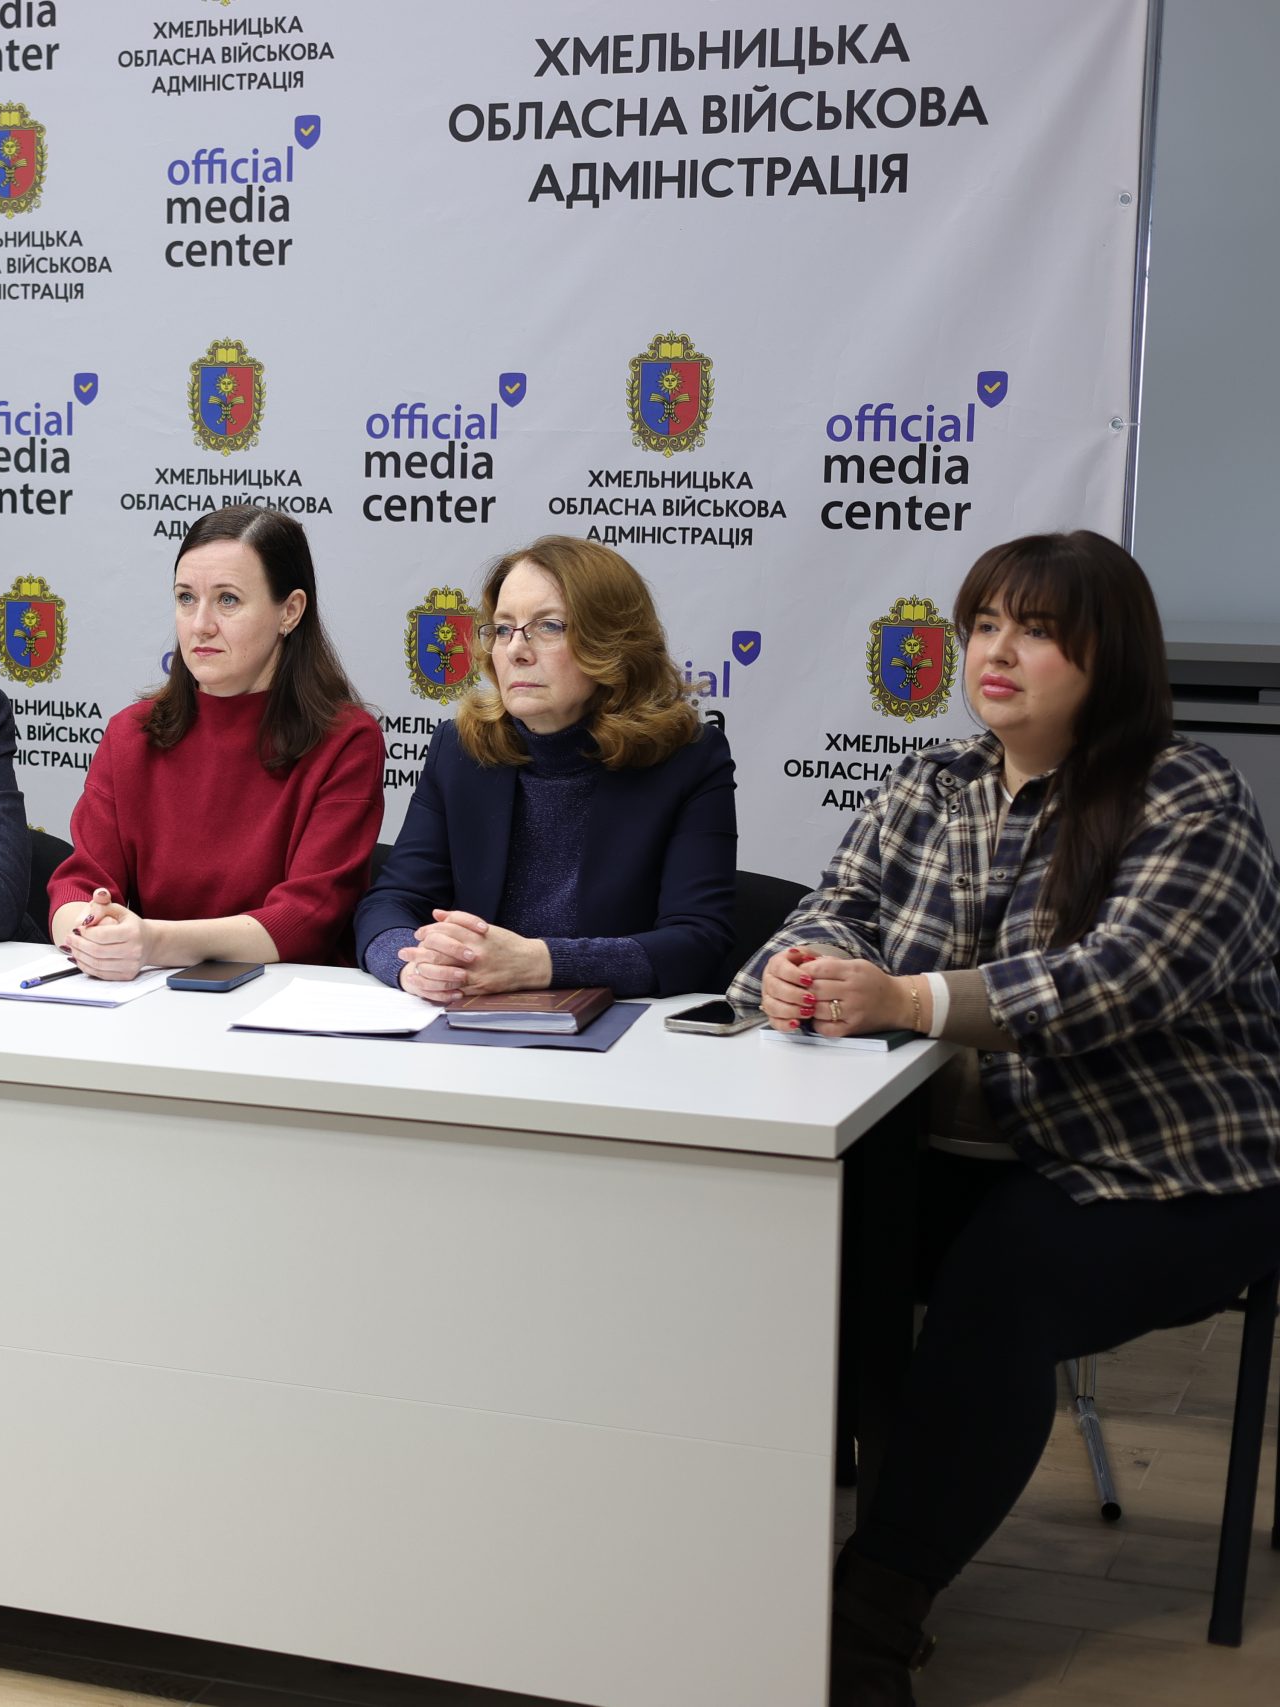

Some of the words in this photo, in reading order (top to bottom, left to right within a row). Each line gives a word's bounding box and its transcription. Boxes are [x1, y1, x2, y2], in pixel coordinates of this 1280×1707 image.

[153, 15, 304, 40] ХМЕЛЬНИЦЬКА
[117, 47, 216, 69] ОБЛАСНА
[220, 41, 335, 64] ВІЙСЬКОВА
[534, 22, 911, 78] ХМЕЛЬНИЦЬКА
[151, 70, 304, 97] АДМІНІСТРАЦІЯ
[448, 96, 688, 143] ОБЛАСНА
[702, 84, 989, 136] ВІЙСЬКОВА
[167, 145, 294, 187] official
[527, 152, 909, 210] АДМІНІСТРАЦІЯ
[166, 184, 290, 225] media
[6, 254, 113, 275] ВІЙСЬКОВА
[165, 233, 293, 268] center
[365, 402, 498, 441] official
[825, 402, 976, 444] official
[364, 441, 494, 480] media
[823, 443, 970, 485] media
[155, 467, 303, 489] ХМЕЛЬНИЦЬКА
[587, 469, 754, 493] ХМЕЛЬНИЦЬКА
[120, 493, 216, 511] ОБЛАСНА
[362, 489, 497, 524] center
[548, 497, 657, 517] ОБЛАСНА
[662, 495, 787, 519] ВІЙСЬКОВА
[820, 495, 972, 533] center
[586, 525, 754, 549] АДМІНІСТРАЦІЯ
[9, 698, 103, 720] ЬНИЦЬКА
[27, 722, 105, 744] ВІЙСЬКО
[825, 732, 950, 754] ХМЕЛЬНИ
